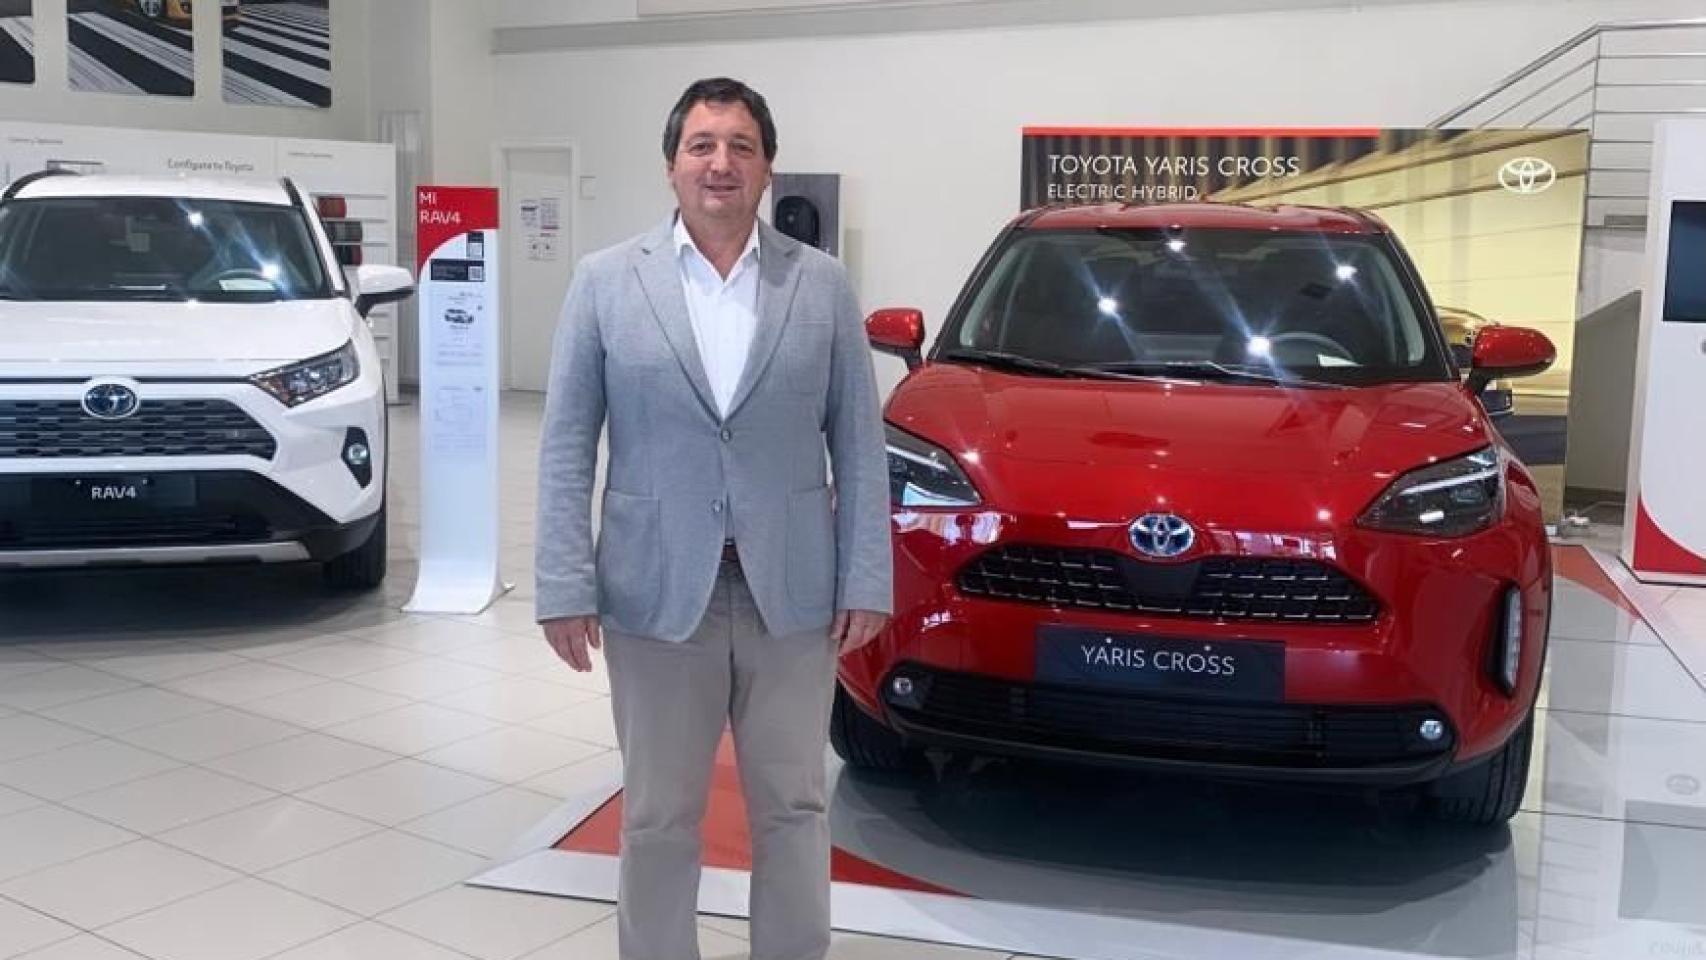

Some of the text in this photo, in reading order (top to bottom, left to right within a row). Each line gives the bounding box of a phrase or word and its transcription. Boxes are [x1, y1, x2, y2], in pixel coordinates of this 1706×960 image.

[1047, 155, 1300, 177] TOYOTA YARIS CROSS
[420, 191, 437, 205] MI
[1047, 184, 1198, 200] ELECTRIC HYBRID
[420, 210, 461, 223] RAV4
[91, 486, 136, 499] RAV4
[1081, 645, 1235, 675] YARIS CROSS
